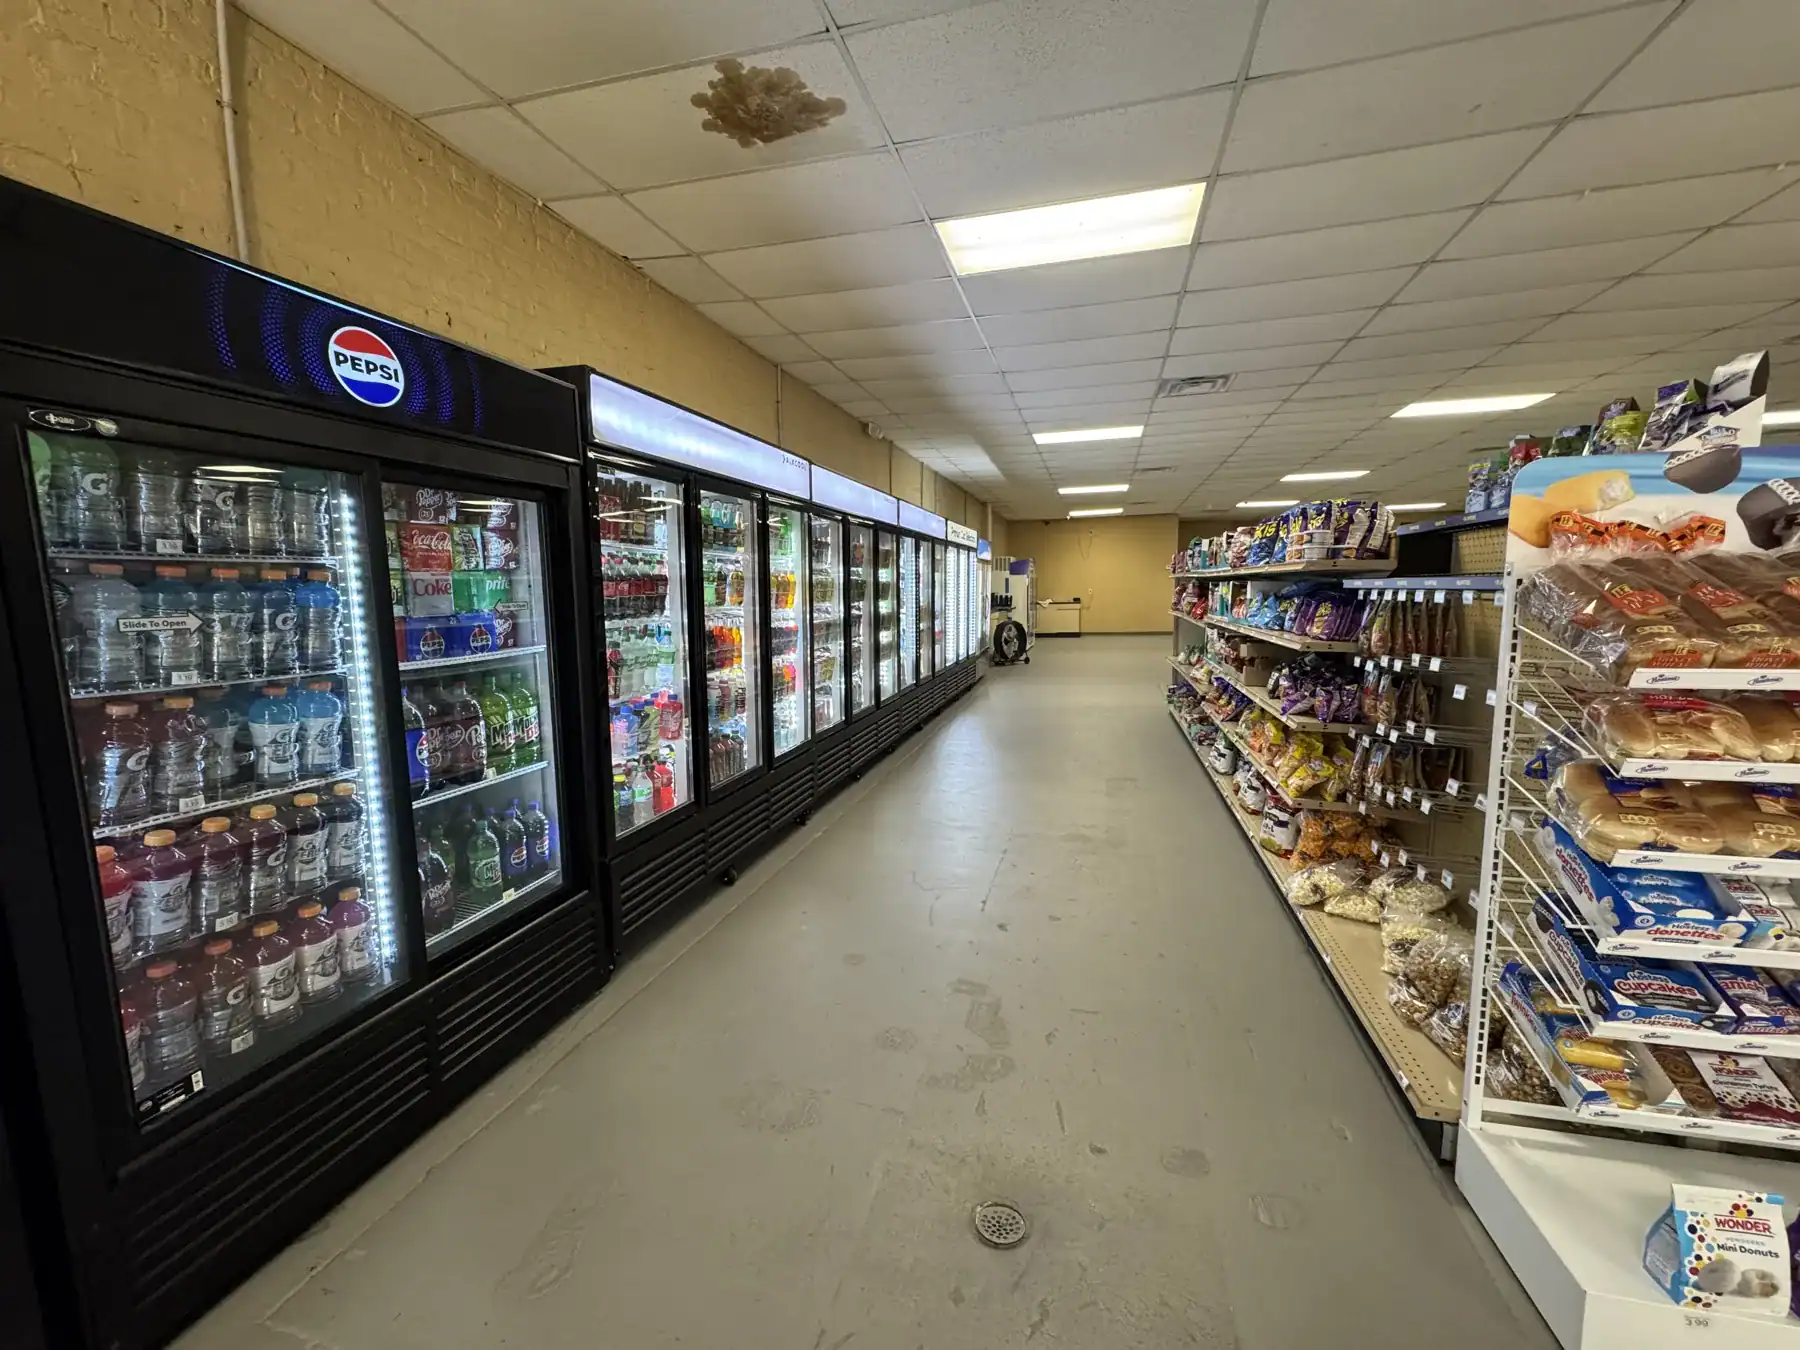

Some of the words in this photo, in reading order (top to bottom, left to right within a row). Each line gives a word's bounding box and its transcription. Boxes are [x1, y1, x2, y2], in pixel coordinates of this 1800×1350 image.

[333, 350, 400, 383] PEPSI
[413, 579, 452, 596] Coke
[122, 620, 148, 629] Slide
[150, 620, 160, 628] To
[162, 619, 187, 629] Open
[1647, 927, 1724, 941] donettes
[1617, 981, 1699, 997] Cupcakes
[1722, 979, 1763, 991] anish
[1632, 1018, 1702, 1031] Cupcakes
[1714, 1217, 1773, 1234] WONDER
[1717, 1243, 1738, 1252] Mini
[1739, 1245, 1780, 1259] Donuts
